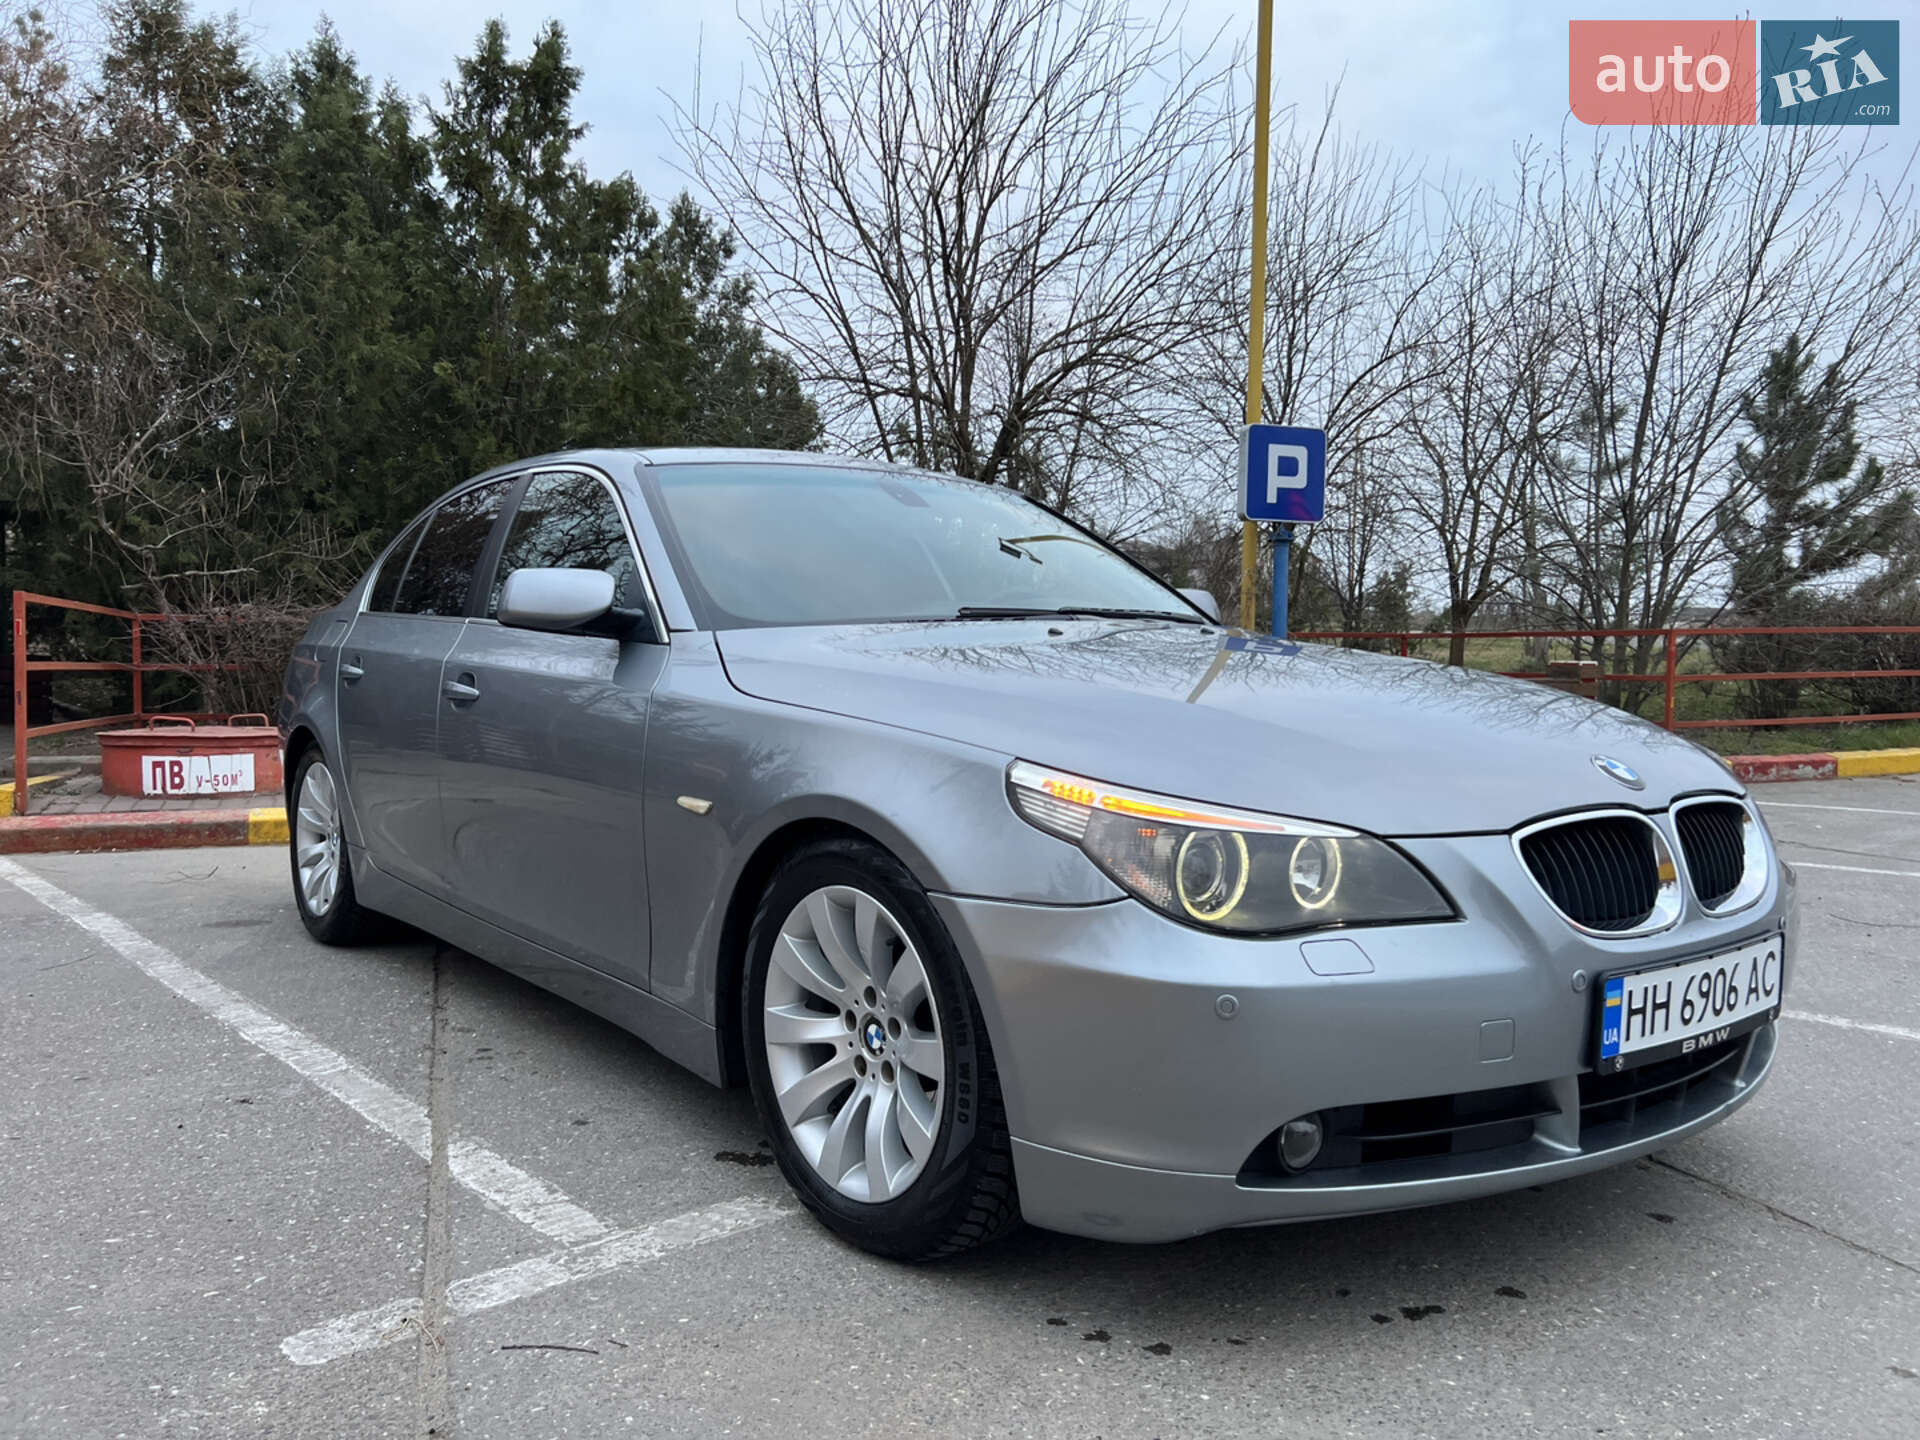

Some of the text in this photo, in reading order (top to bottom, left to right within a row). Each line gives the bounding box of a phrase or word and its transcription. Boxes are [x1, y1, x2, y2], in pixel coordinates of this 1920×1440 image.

[1266, 443, 1308, 504] P
[151, 760, 185, 791] ПВ
[1625, 950, 1776, 1042] HH 6906 AC
[1603, 1028, 1618, 1045] UA
[1682, 1027, 1731, 1054] BMW
